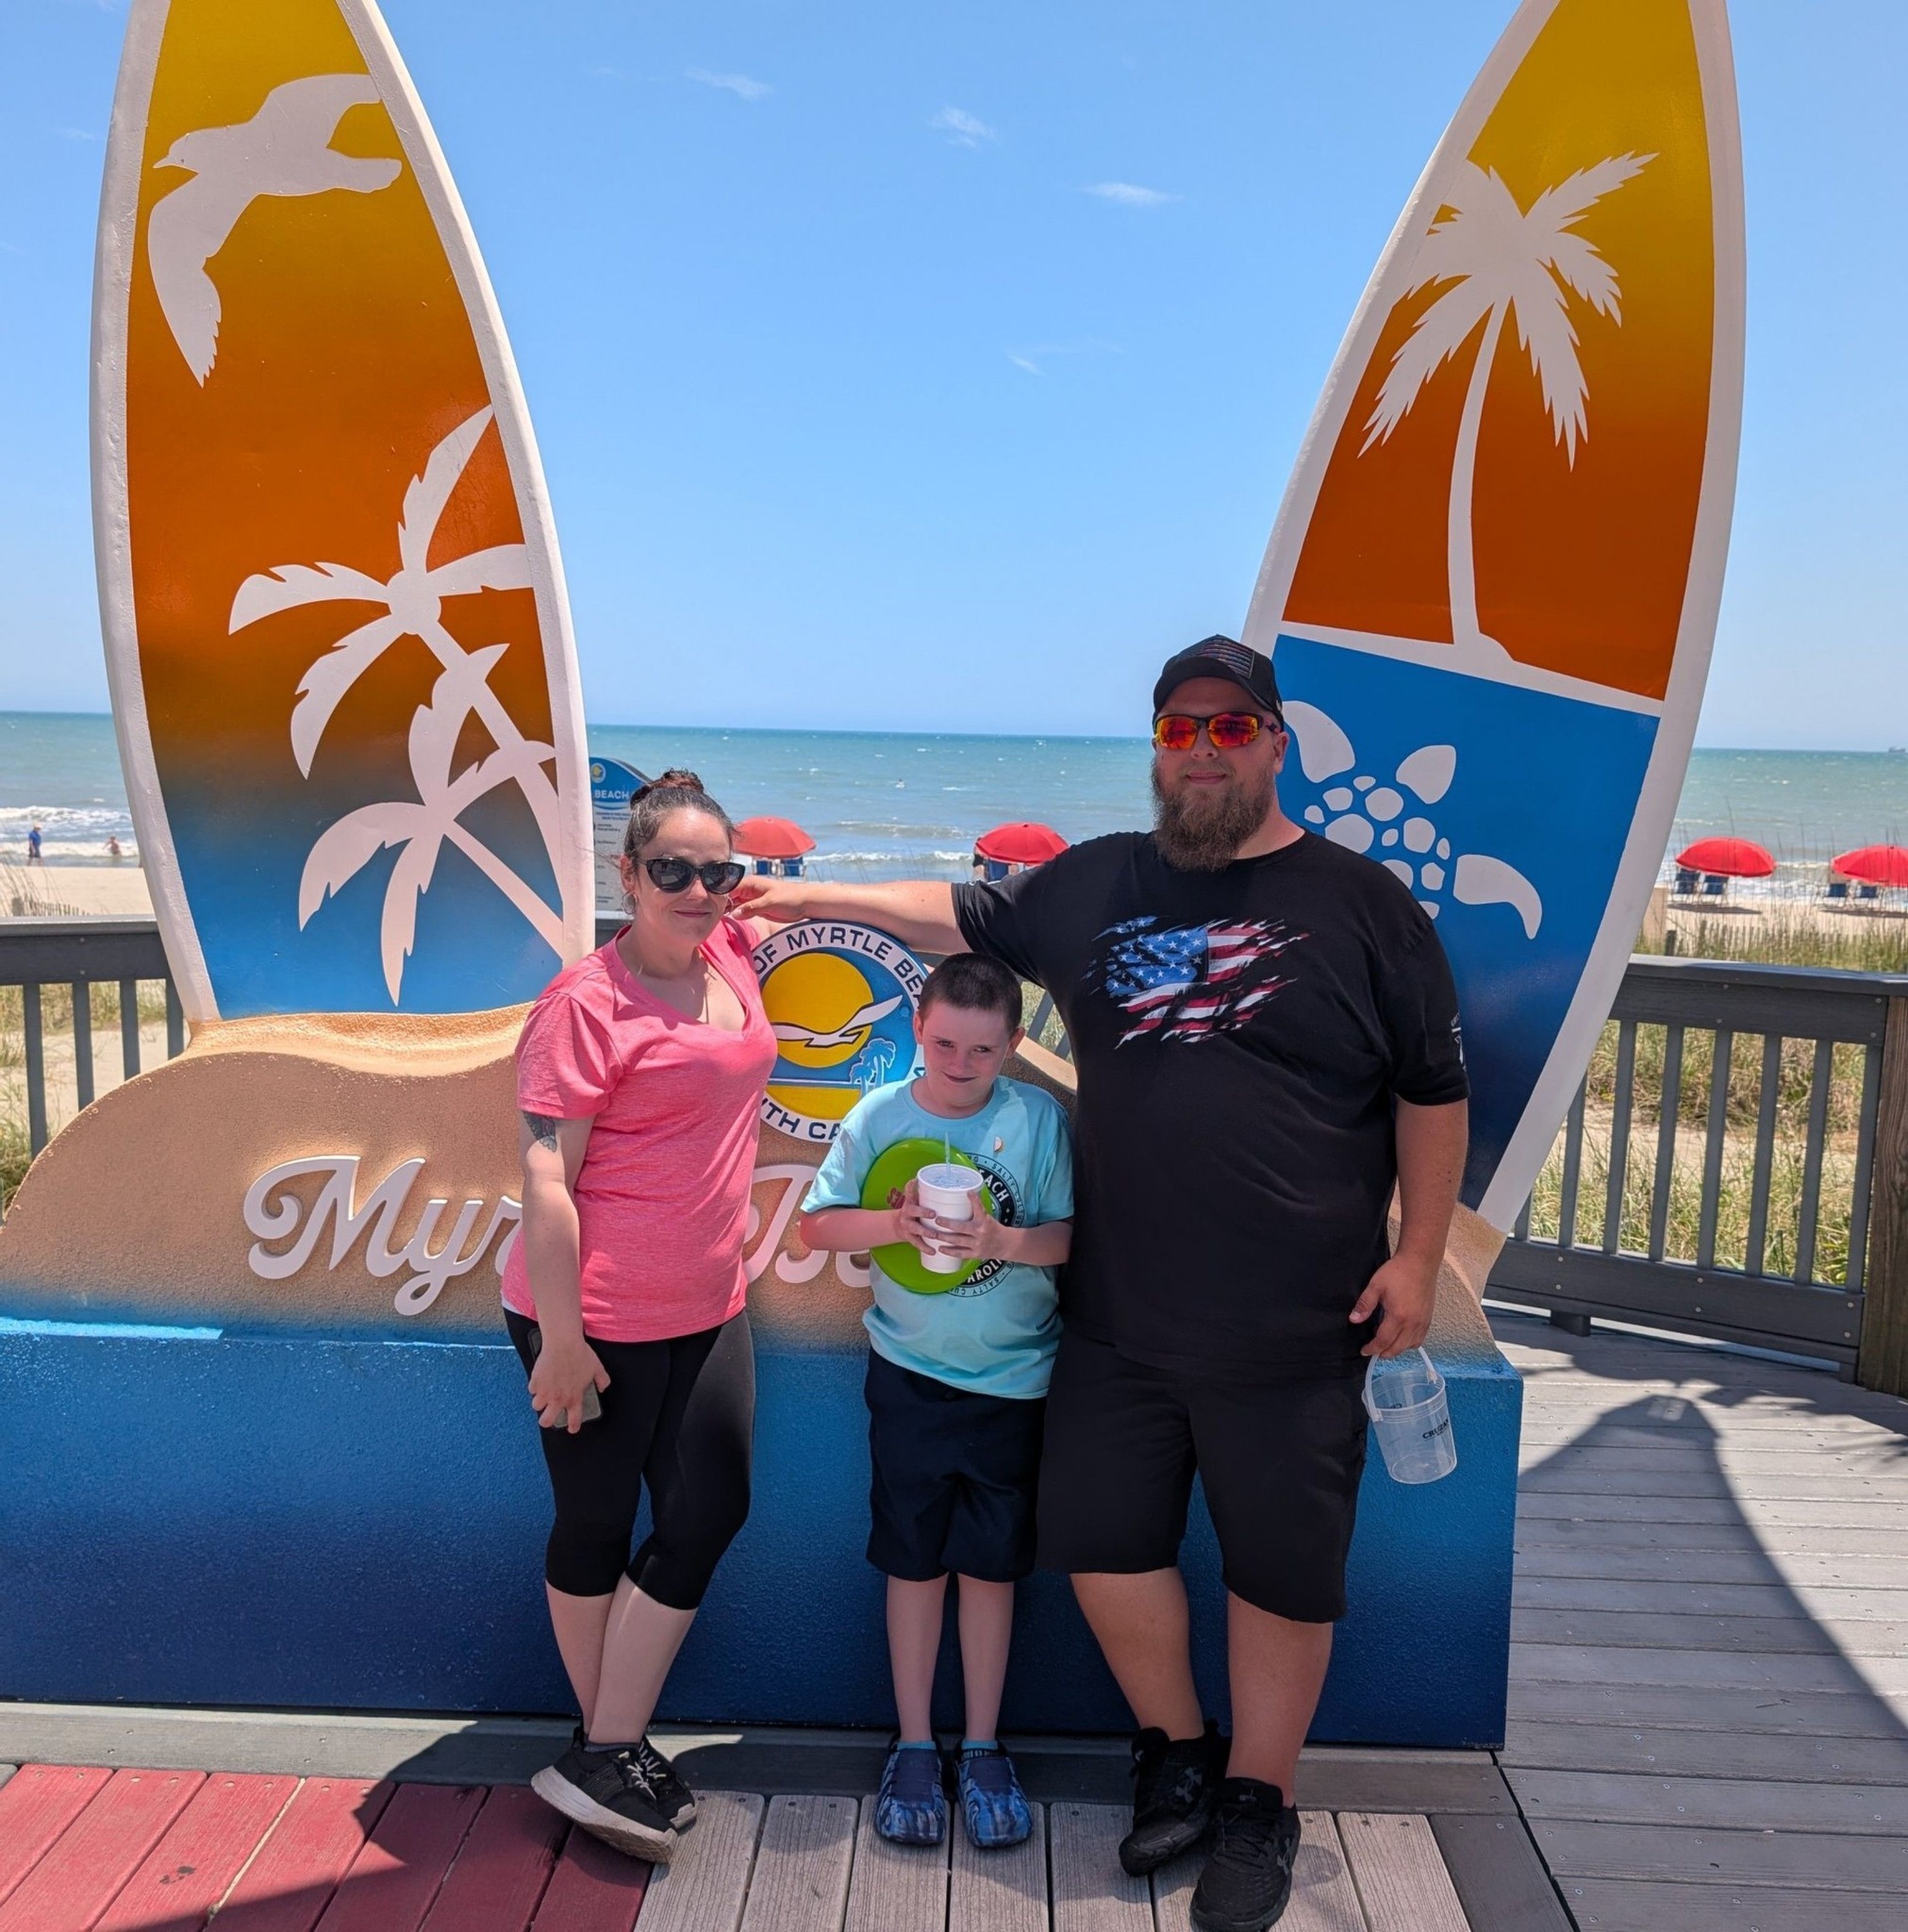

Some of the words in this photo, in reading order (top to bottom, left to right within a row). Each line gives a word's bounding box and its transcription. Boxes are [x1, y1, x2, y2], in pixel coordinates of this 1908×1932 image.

[594, 790, 629, 799] BEACH
[754, 943, 777, 974] OF
[786, 926, 892, 960] MYRTLE
[991, 1163, 1016, 1187] SALTY
[972, 1276, 1000, 1295] SALTY
